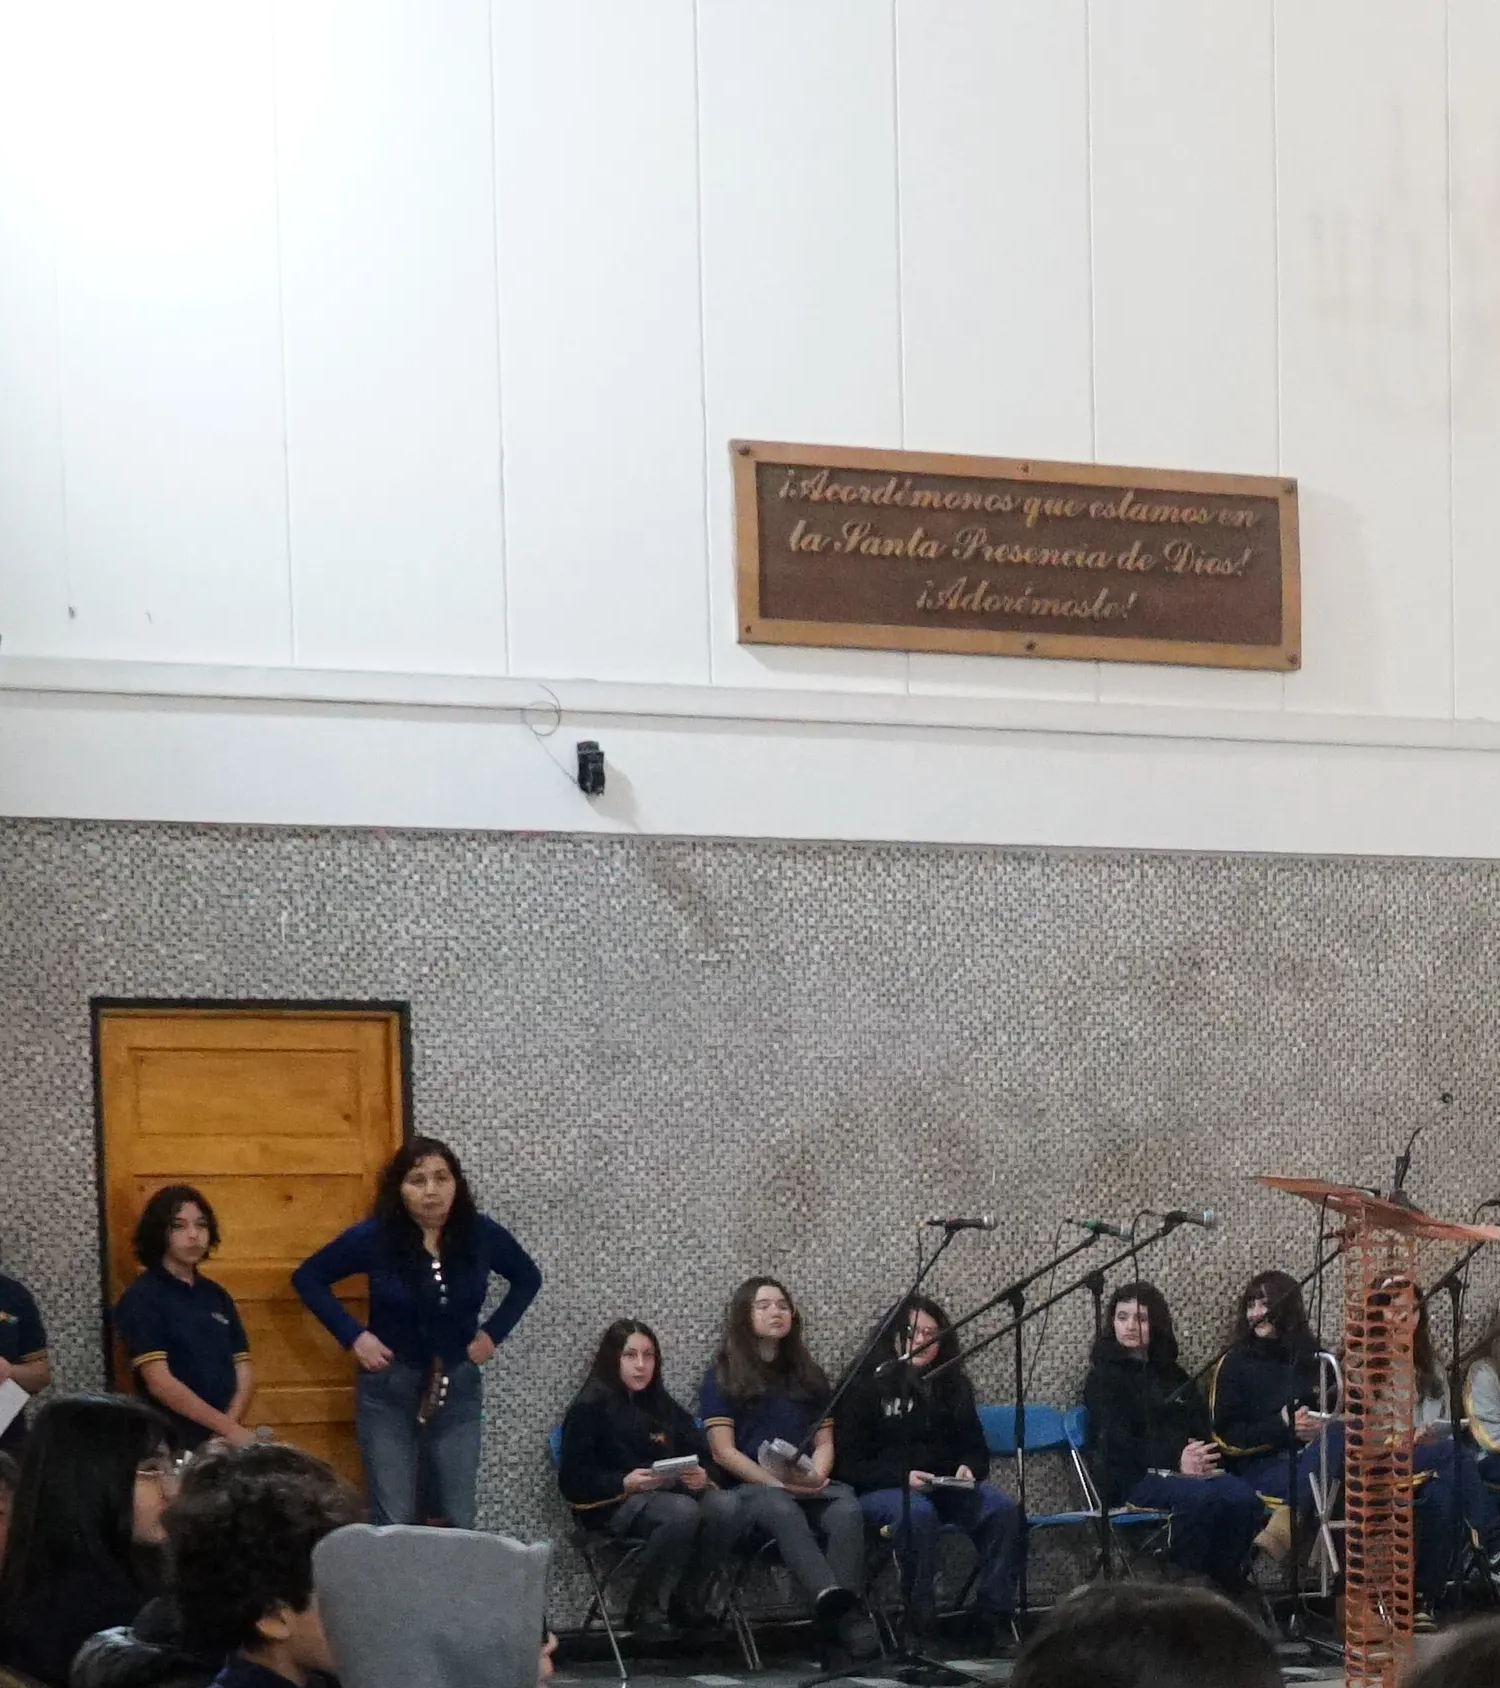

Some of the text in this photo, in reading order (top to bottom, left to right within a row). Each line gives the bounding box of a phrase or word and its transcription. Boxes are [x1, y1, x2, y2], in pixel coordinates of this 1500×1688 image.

[1023, 496, 1084, 528] que
[1088, 490, 1216, 525] estamos
[1217, 508, 1260, 528] en
[789, 519, 1252, 577] la Santa Presencia de Dios!
